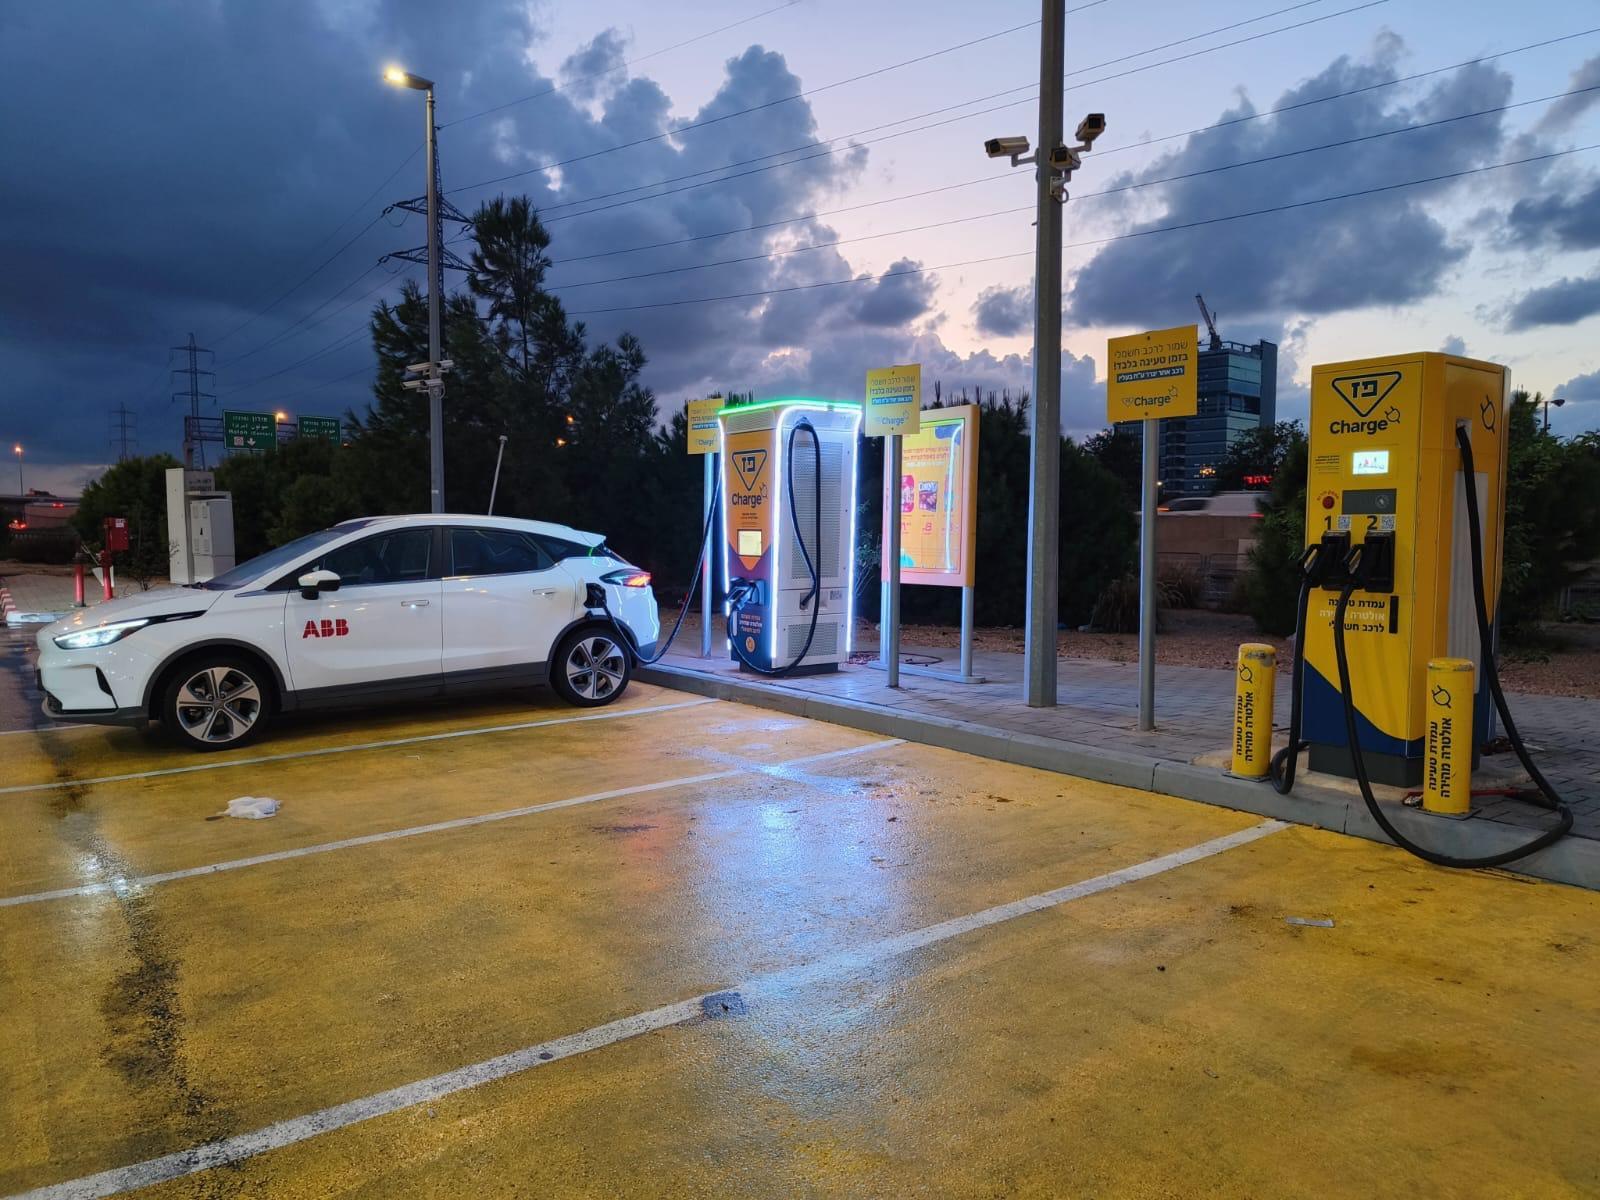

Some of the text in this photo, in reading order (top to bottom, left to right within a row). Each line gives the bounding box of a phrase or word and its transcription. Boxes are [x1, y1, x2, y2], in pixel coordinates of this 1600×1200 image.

[1144, 344, 1164, 354] לרכב
[1167, 341, 1188, 351] שמור
[1114, 354, 1188, 370] בזמן טעינה בלבד!
[1352, 380, 1377, 398] פז
[1134, 396, 1171, 406] Charge
[1330, 420, 1388, 435] Charge
[742, 456, 756, 472] פז
[732, 492, 762, 508] Charge
[1324, 515, 1331, 530] 1
[1367, 516, 1378, 530] 2
[1328, 598, 1355, 607] טנה
[1350, 610, 1385, 620] אולטרה
[303, 619, 349, 639] ABB
[1362, 623, 1384, 632] לרכב
[1244, 692, 1253, 728] אולטרה
[1440, 718, 1452, 798] אולטרה מהירה
